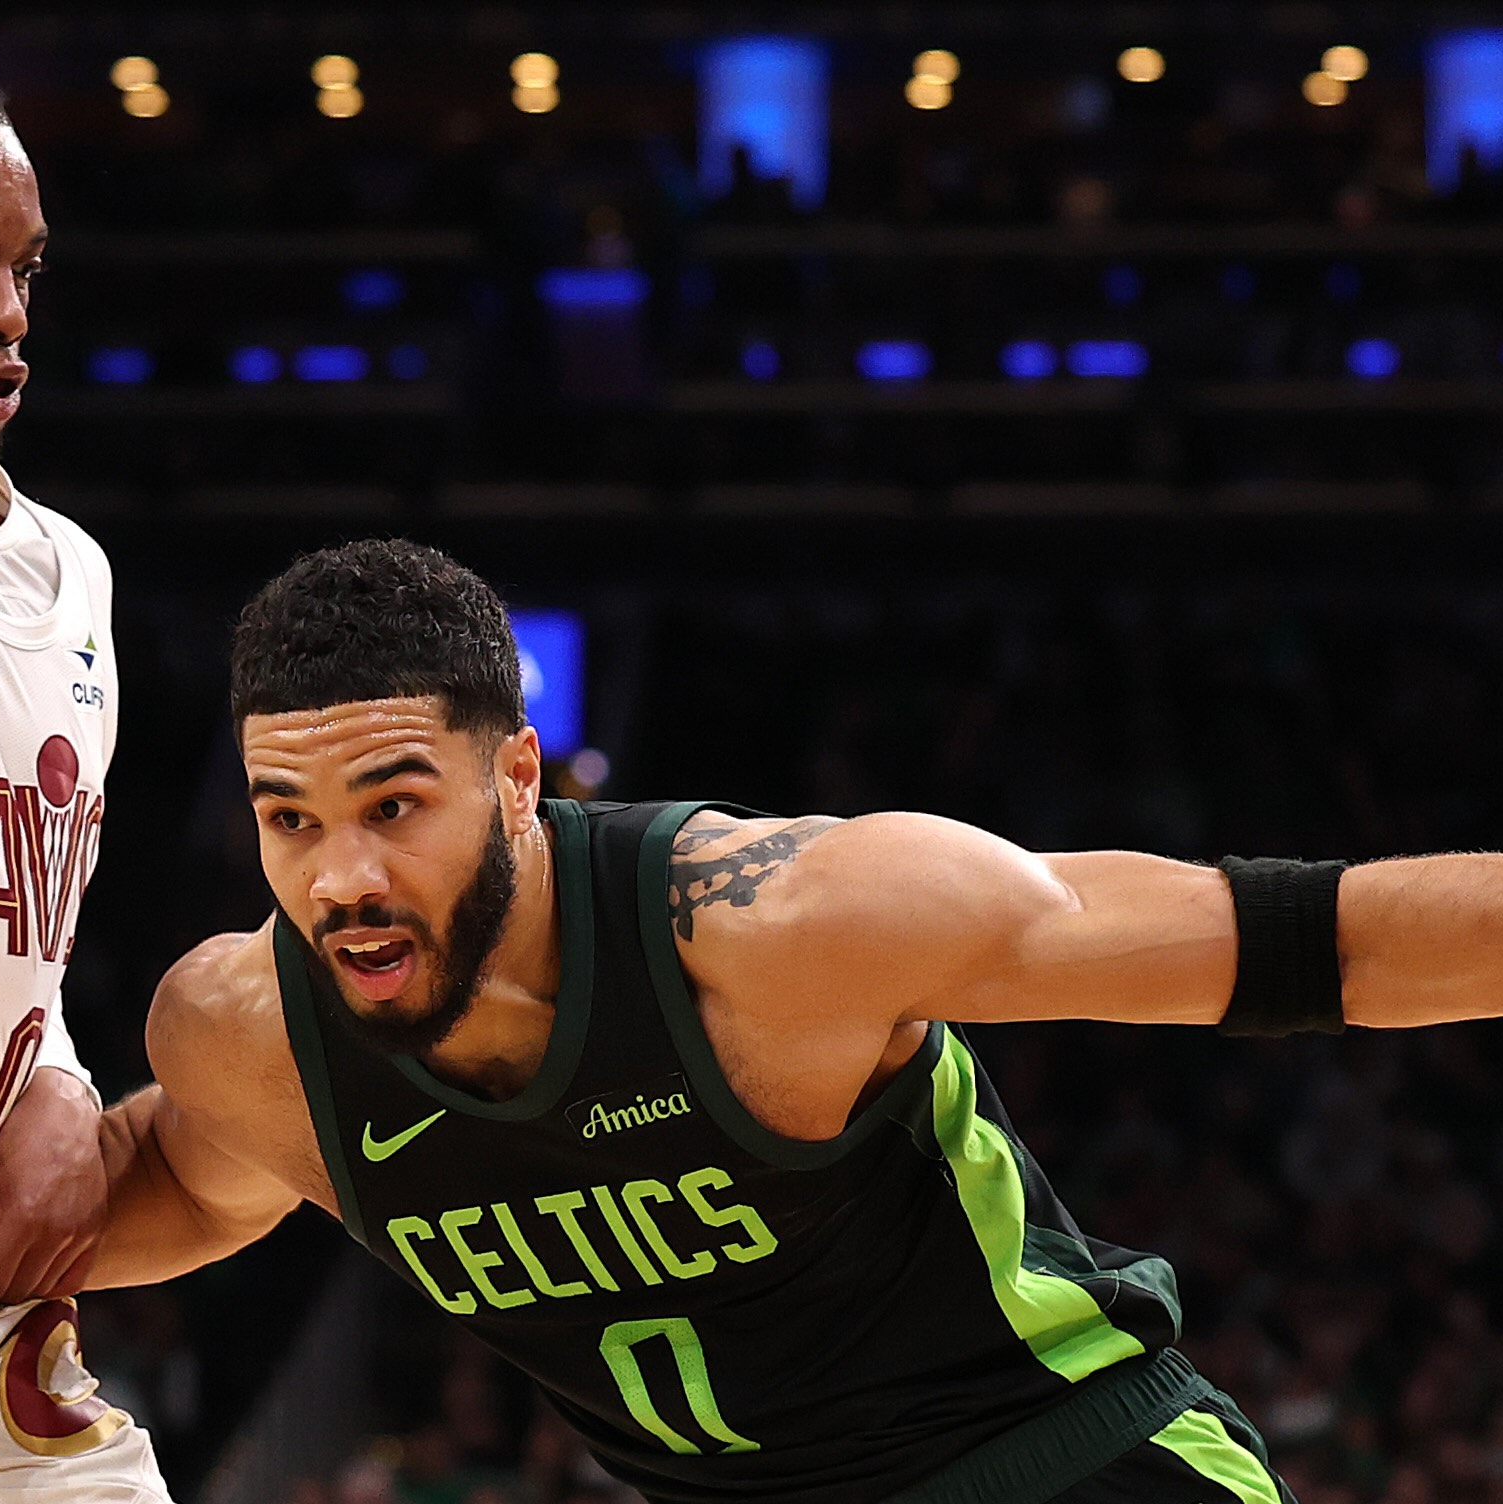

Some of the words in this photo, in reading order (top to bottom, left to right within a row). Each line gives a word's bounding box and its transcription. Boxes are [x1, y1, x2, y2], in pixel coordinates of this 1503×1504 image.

[582, 1089, 691, 1139] Amica
[386, 1166, 779, 1315] CELTICS
[599, 1317, 761, 1455] 0
